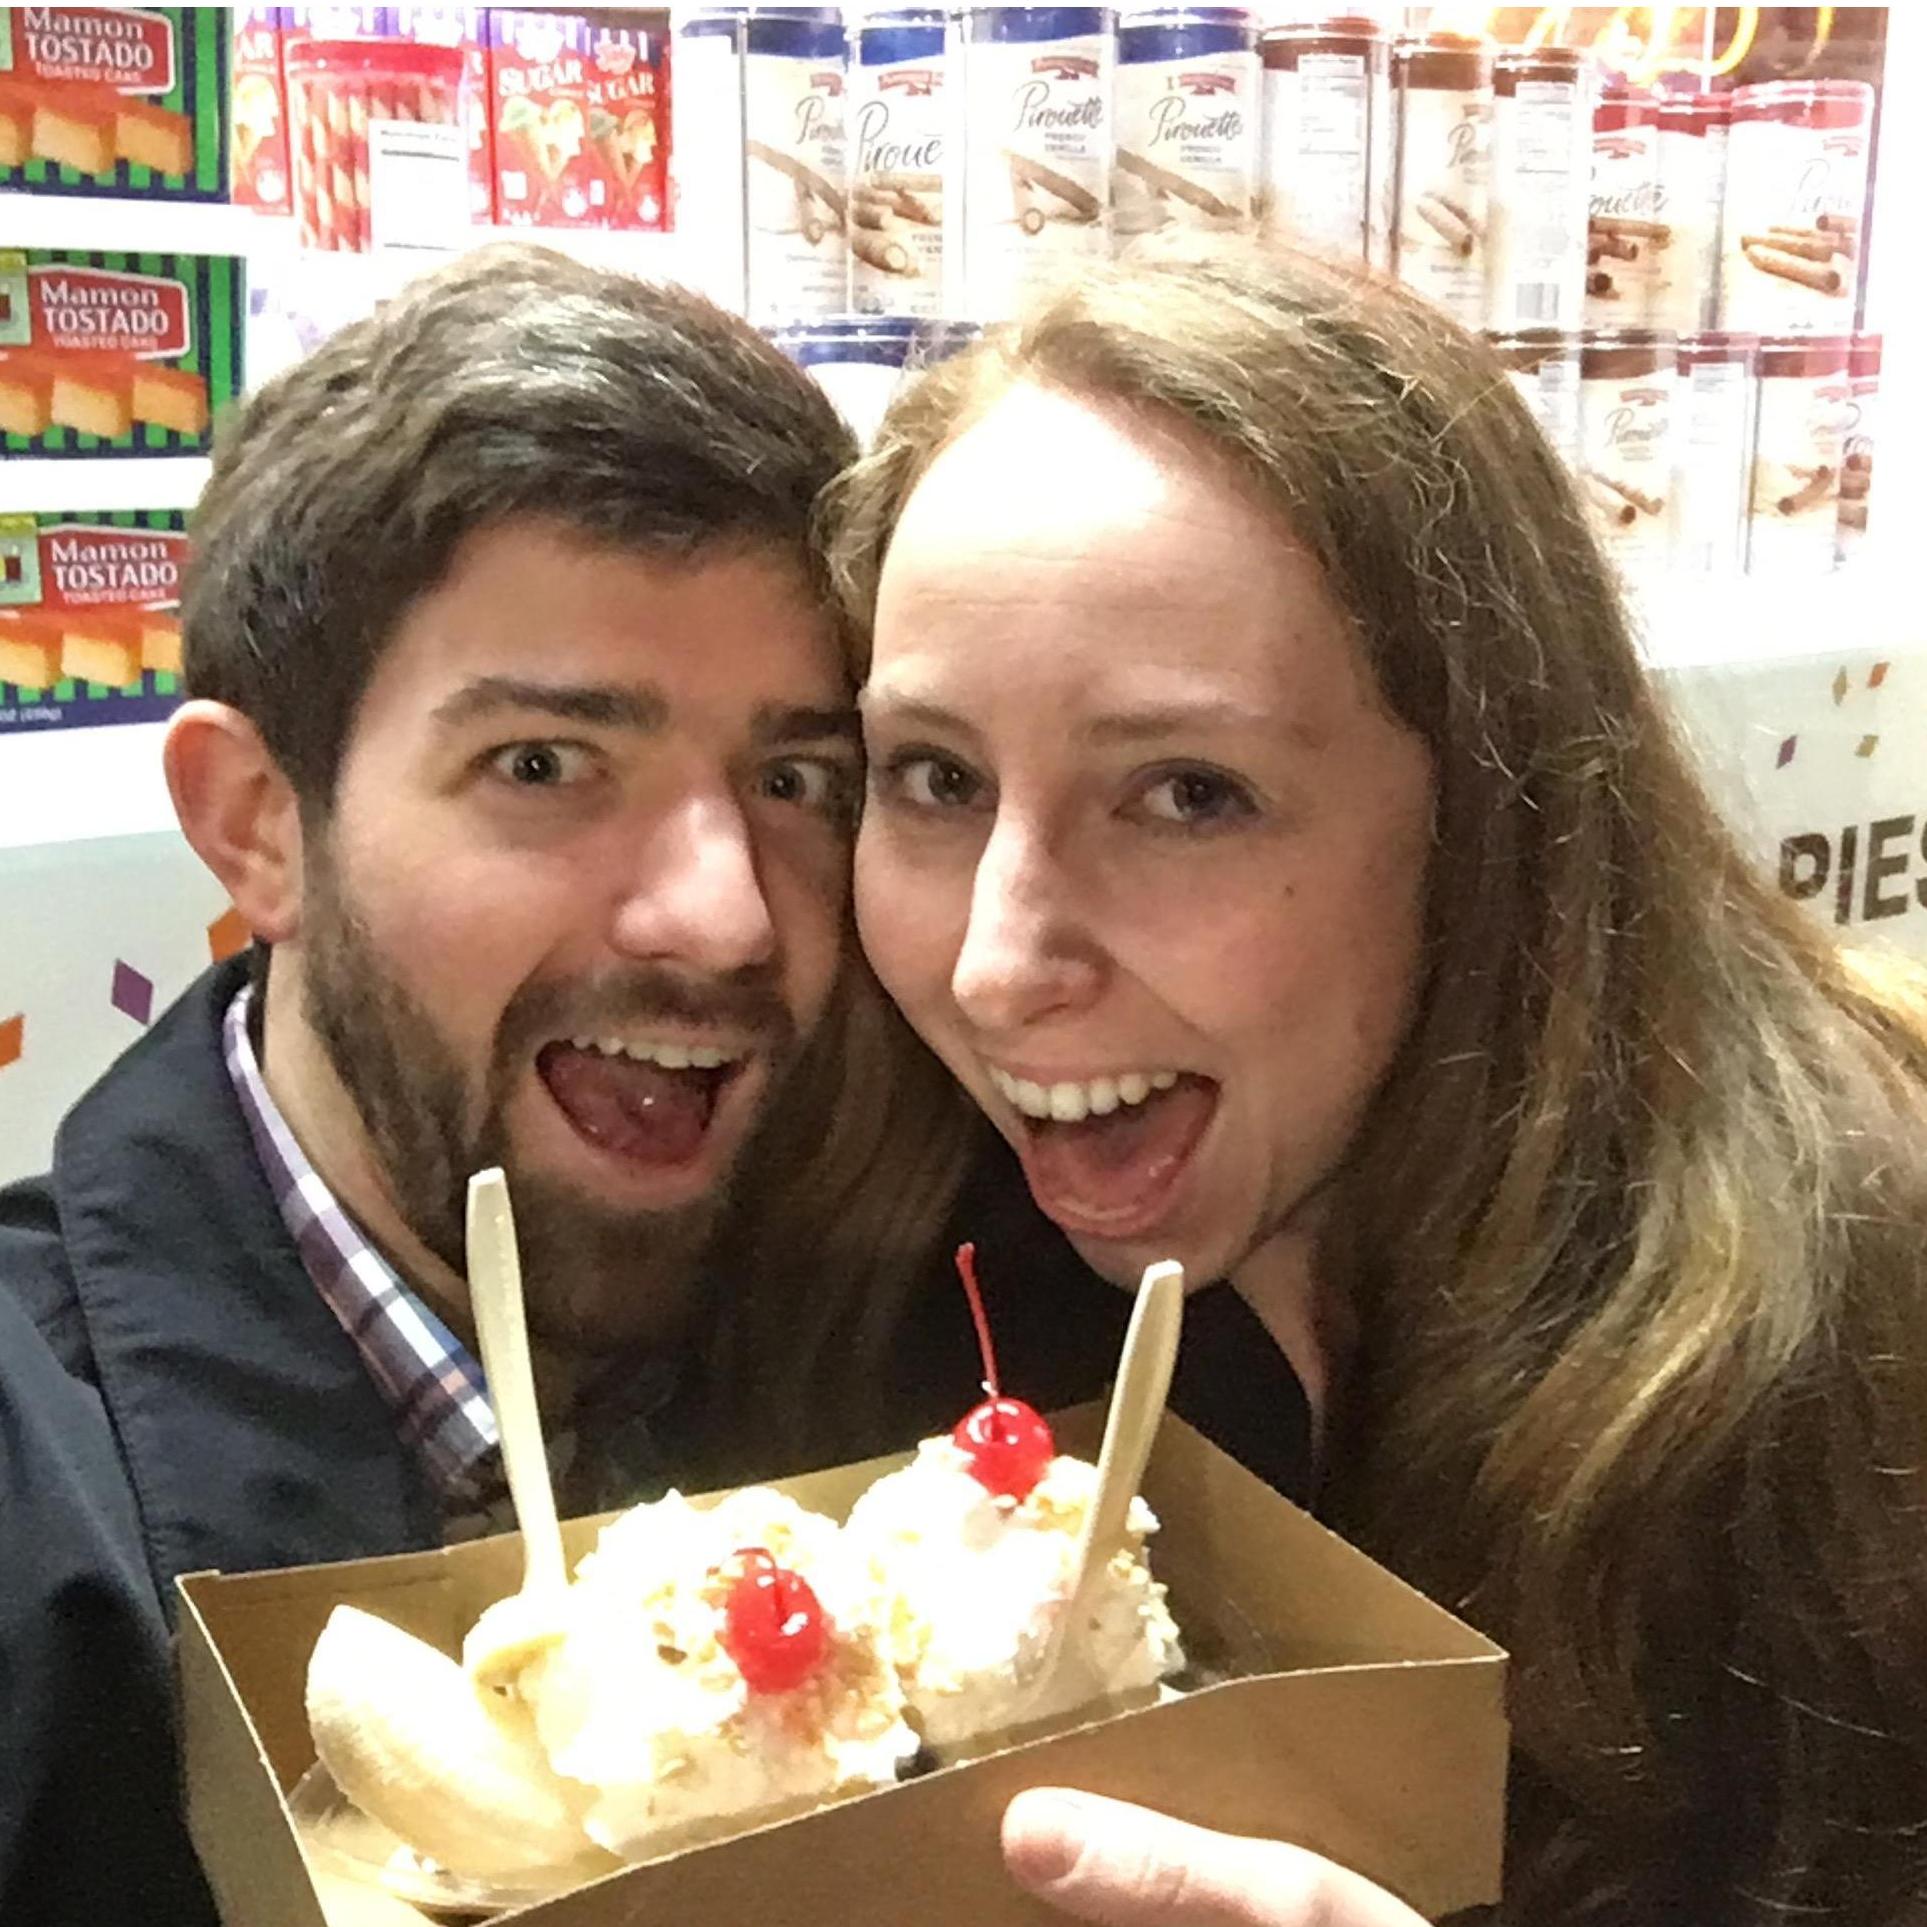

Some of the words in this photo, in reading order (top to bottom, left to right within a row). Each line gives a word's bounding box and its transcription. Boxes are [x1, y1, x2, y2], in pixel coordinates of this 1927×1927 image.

[24, 7, 144, 40] Mamon
[25, 32, 154, 70] TOSTADO
[498, 58, 582, 96] SUGAR
[1013, 80, 1103, 131] Pirouette
[1149, 96, 1243, 147] Pirouette
[854, 100, 944, 175] Piroue
[40, 278, 159, 307] Mamon
[43, 307, 170, 336] TOSTADO
[51, 538, 168, 563] Mamon
[52, 561, 178, 590] TOSTADO
[1779, 815, 1927, 925] PIE
